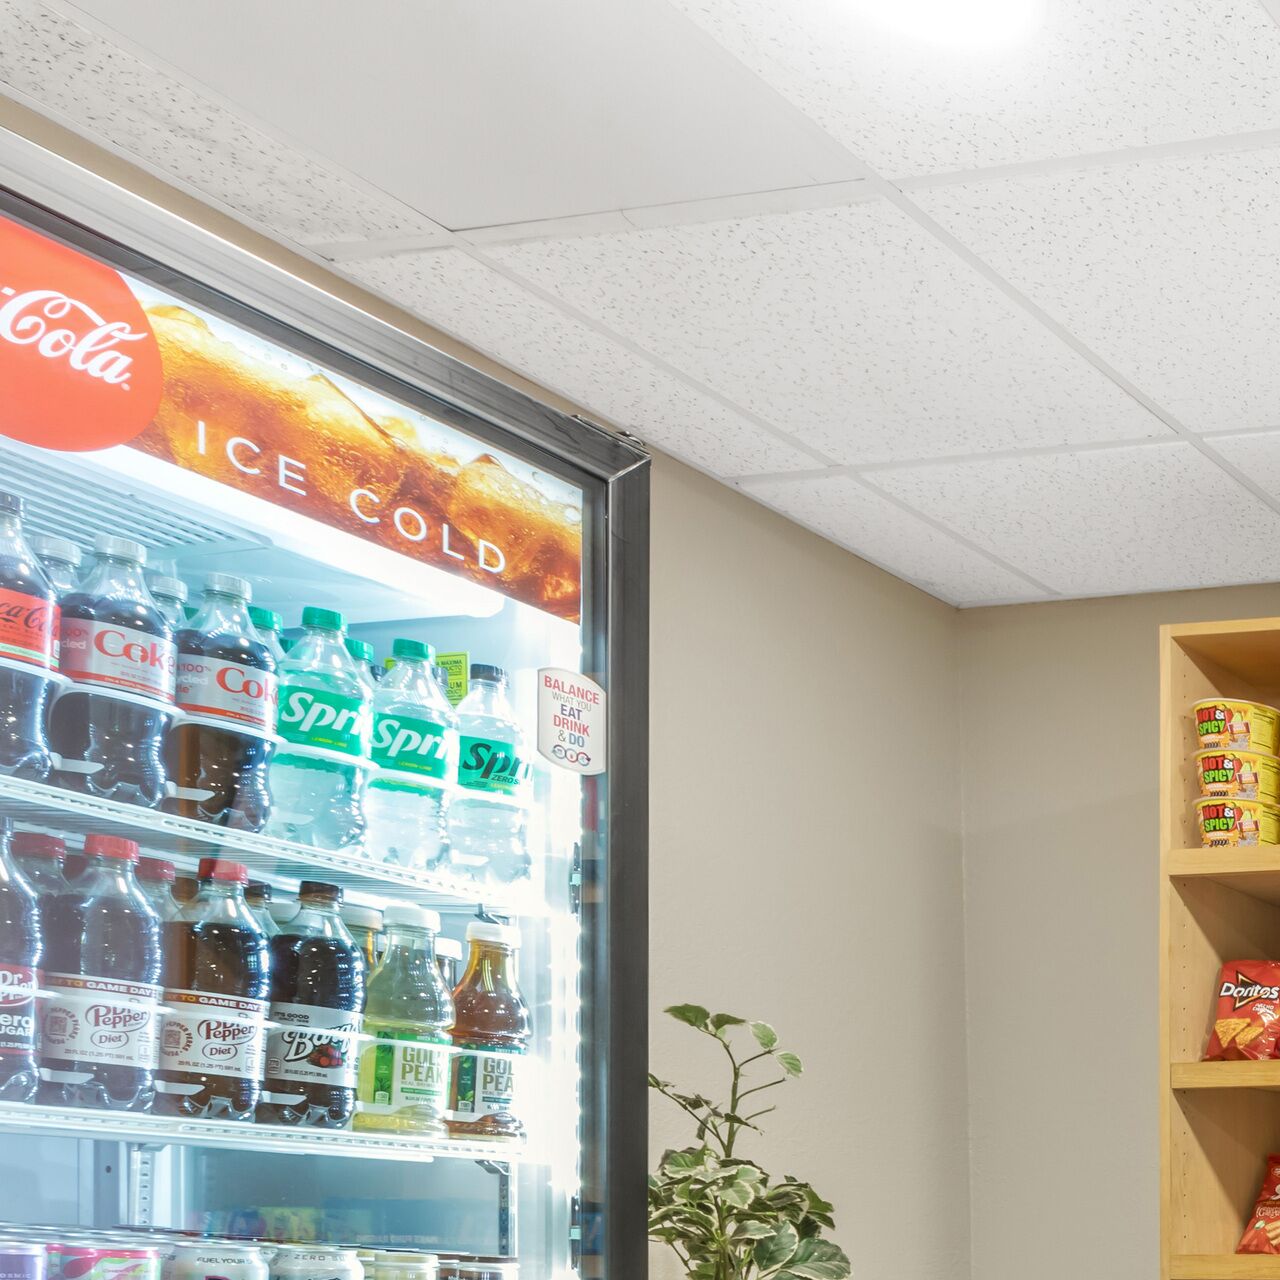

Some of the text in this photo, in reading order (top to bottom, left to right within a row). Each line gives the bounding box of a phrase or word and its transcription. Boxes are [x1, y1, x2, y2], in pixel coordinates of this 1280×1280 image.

[197, 419, 507, 575] ICE COLD
[543, 674, 600, 705] BALANCE
[552, 691, 593, 712] WHAT YOU
[560, 703, 583, 721] EAT
[1196, 707, 1218, 723] HOT
[553, 714, 591, 737] DRINK
[1198, 719, 1225, 736] SPICY
[557, 729, 585, 748] & DO
[1202, 753, 1226, 771] HOT
[491, 774, 515, 784] ZERO
[1202, 767, 1234, 784] SPICY
[1202, 804, 1226, 822] HOT
[1203, 817, 1234, 833] SPICY
[86, 982, 127, 993] GAME
[1219, 981, 1280, 1000] Doritos
[198, 996, 238, 1010] GAME
[92, 1004, 148, 1030] Pepper
[98, 1033, 123, 1044] Diet
[203, 1020, 256, 1042] Pepper
[209, 1046, 232, 1057] Diet
[400, 1063, 444, 1083] PEAK
